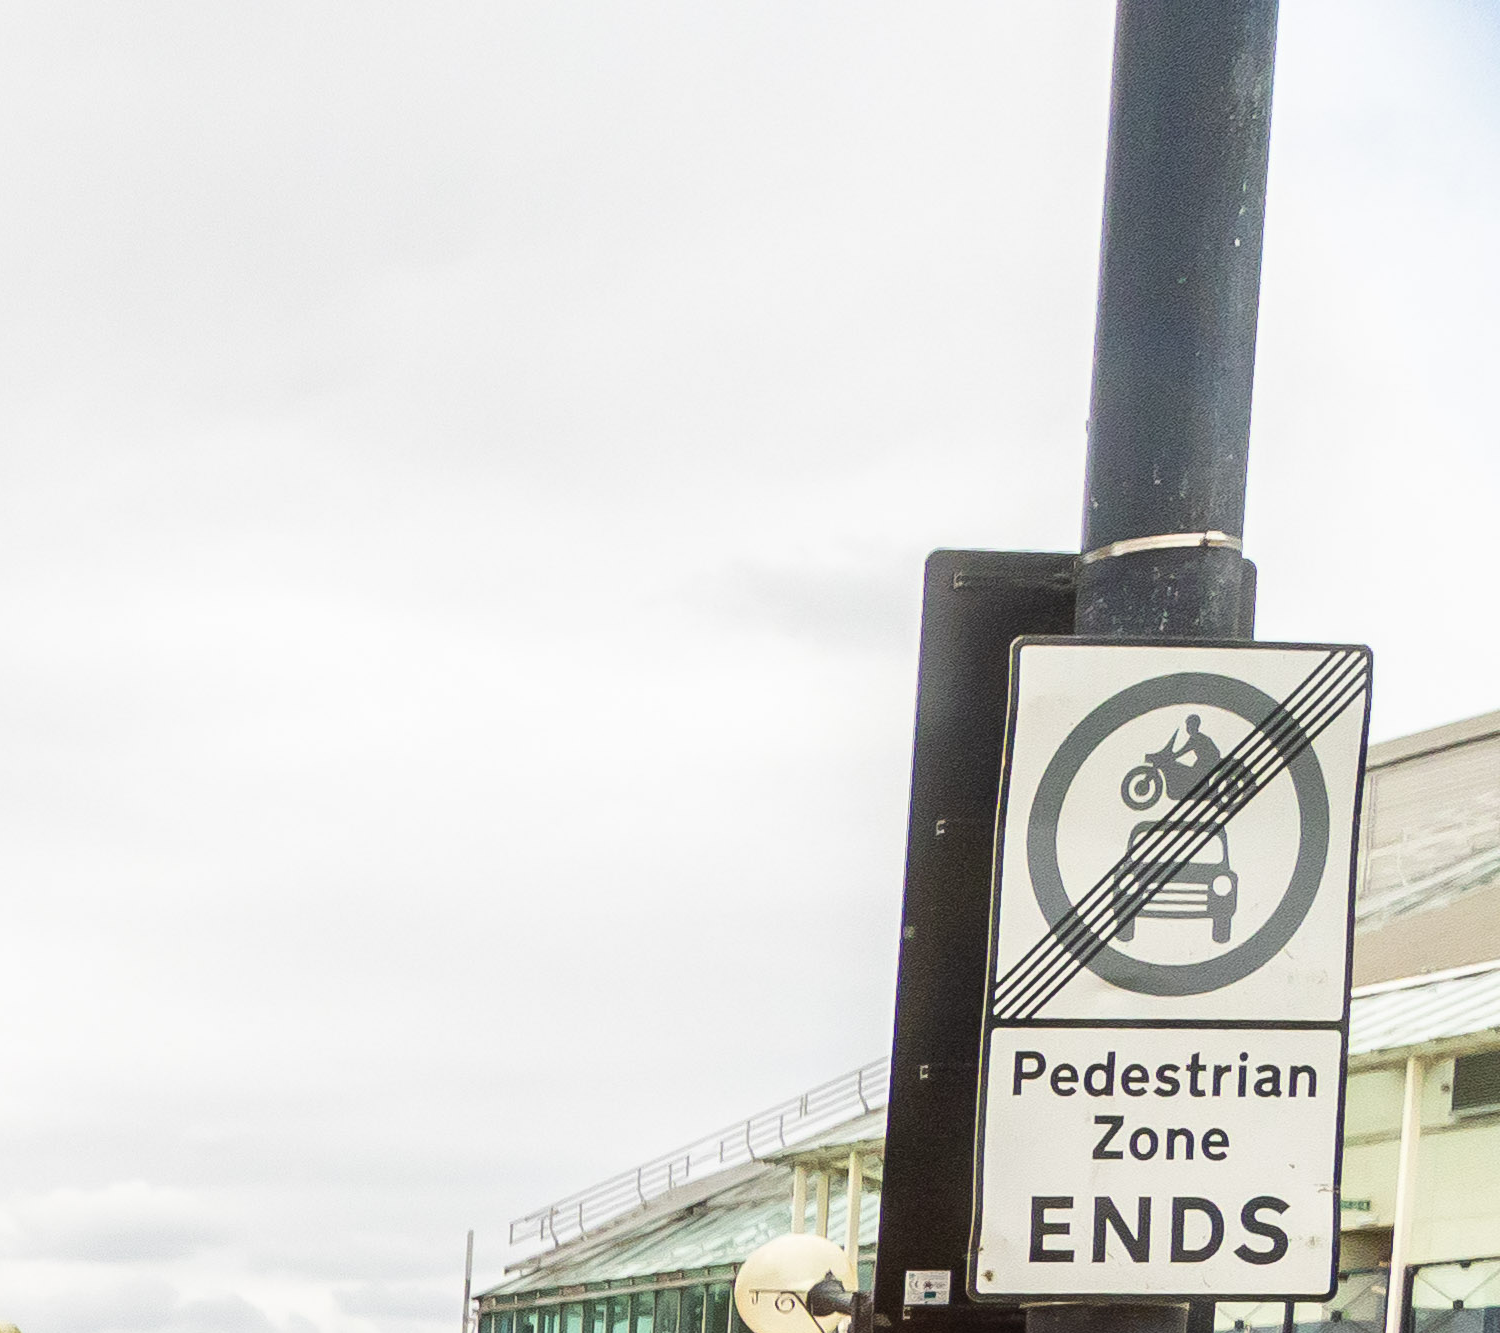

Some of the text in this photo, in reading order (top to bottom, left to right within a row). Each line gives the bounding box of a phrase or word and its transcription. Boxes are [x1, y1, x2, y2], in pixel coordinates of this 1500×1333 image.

[1012, 1050, 1319, 1099] Pedestrian
[1091, 1113, 1231, 1162] Zone
[1028, 1194, 1292, 1266] ENDS
